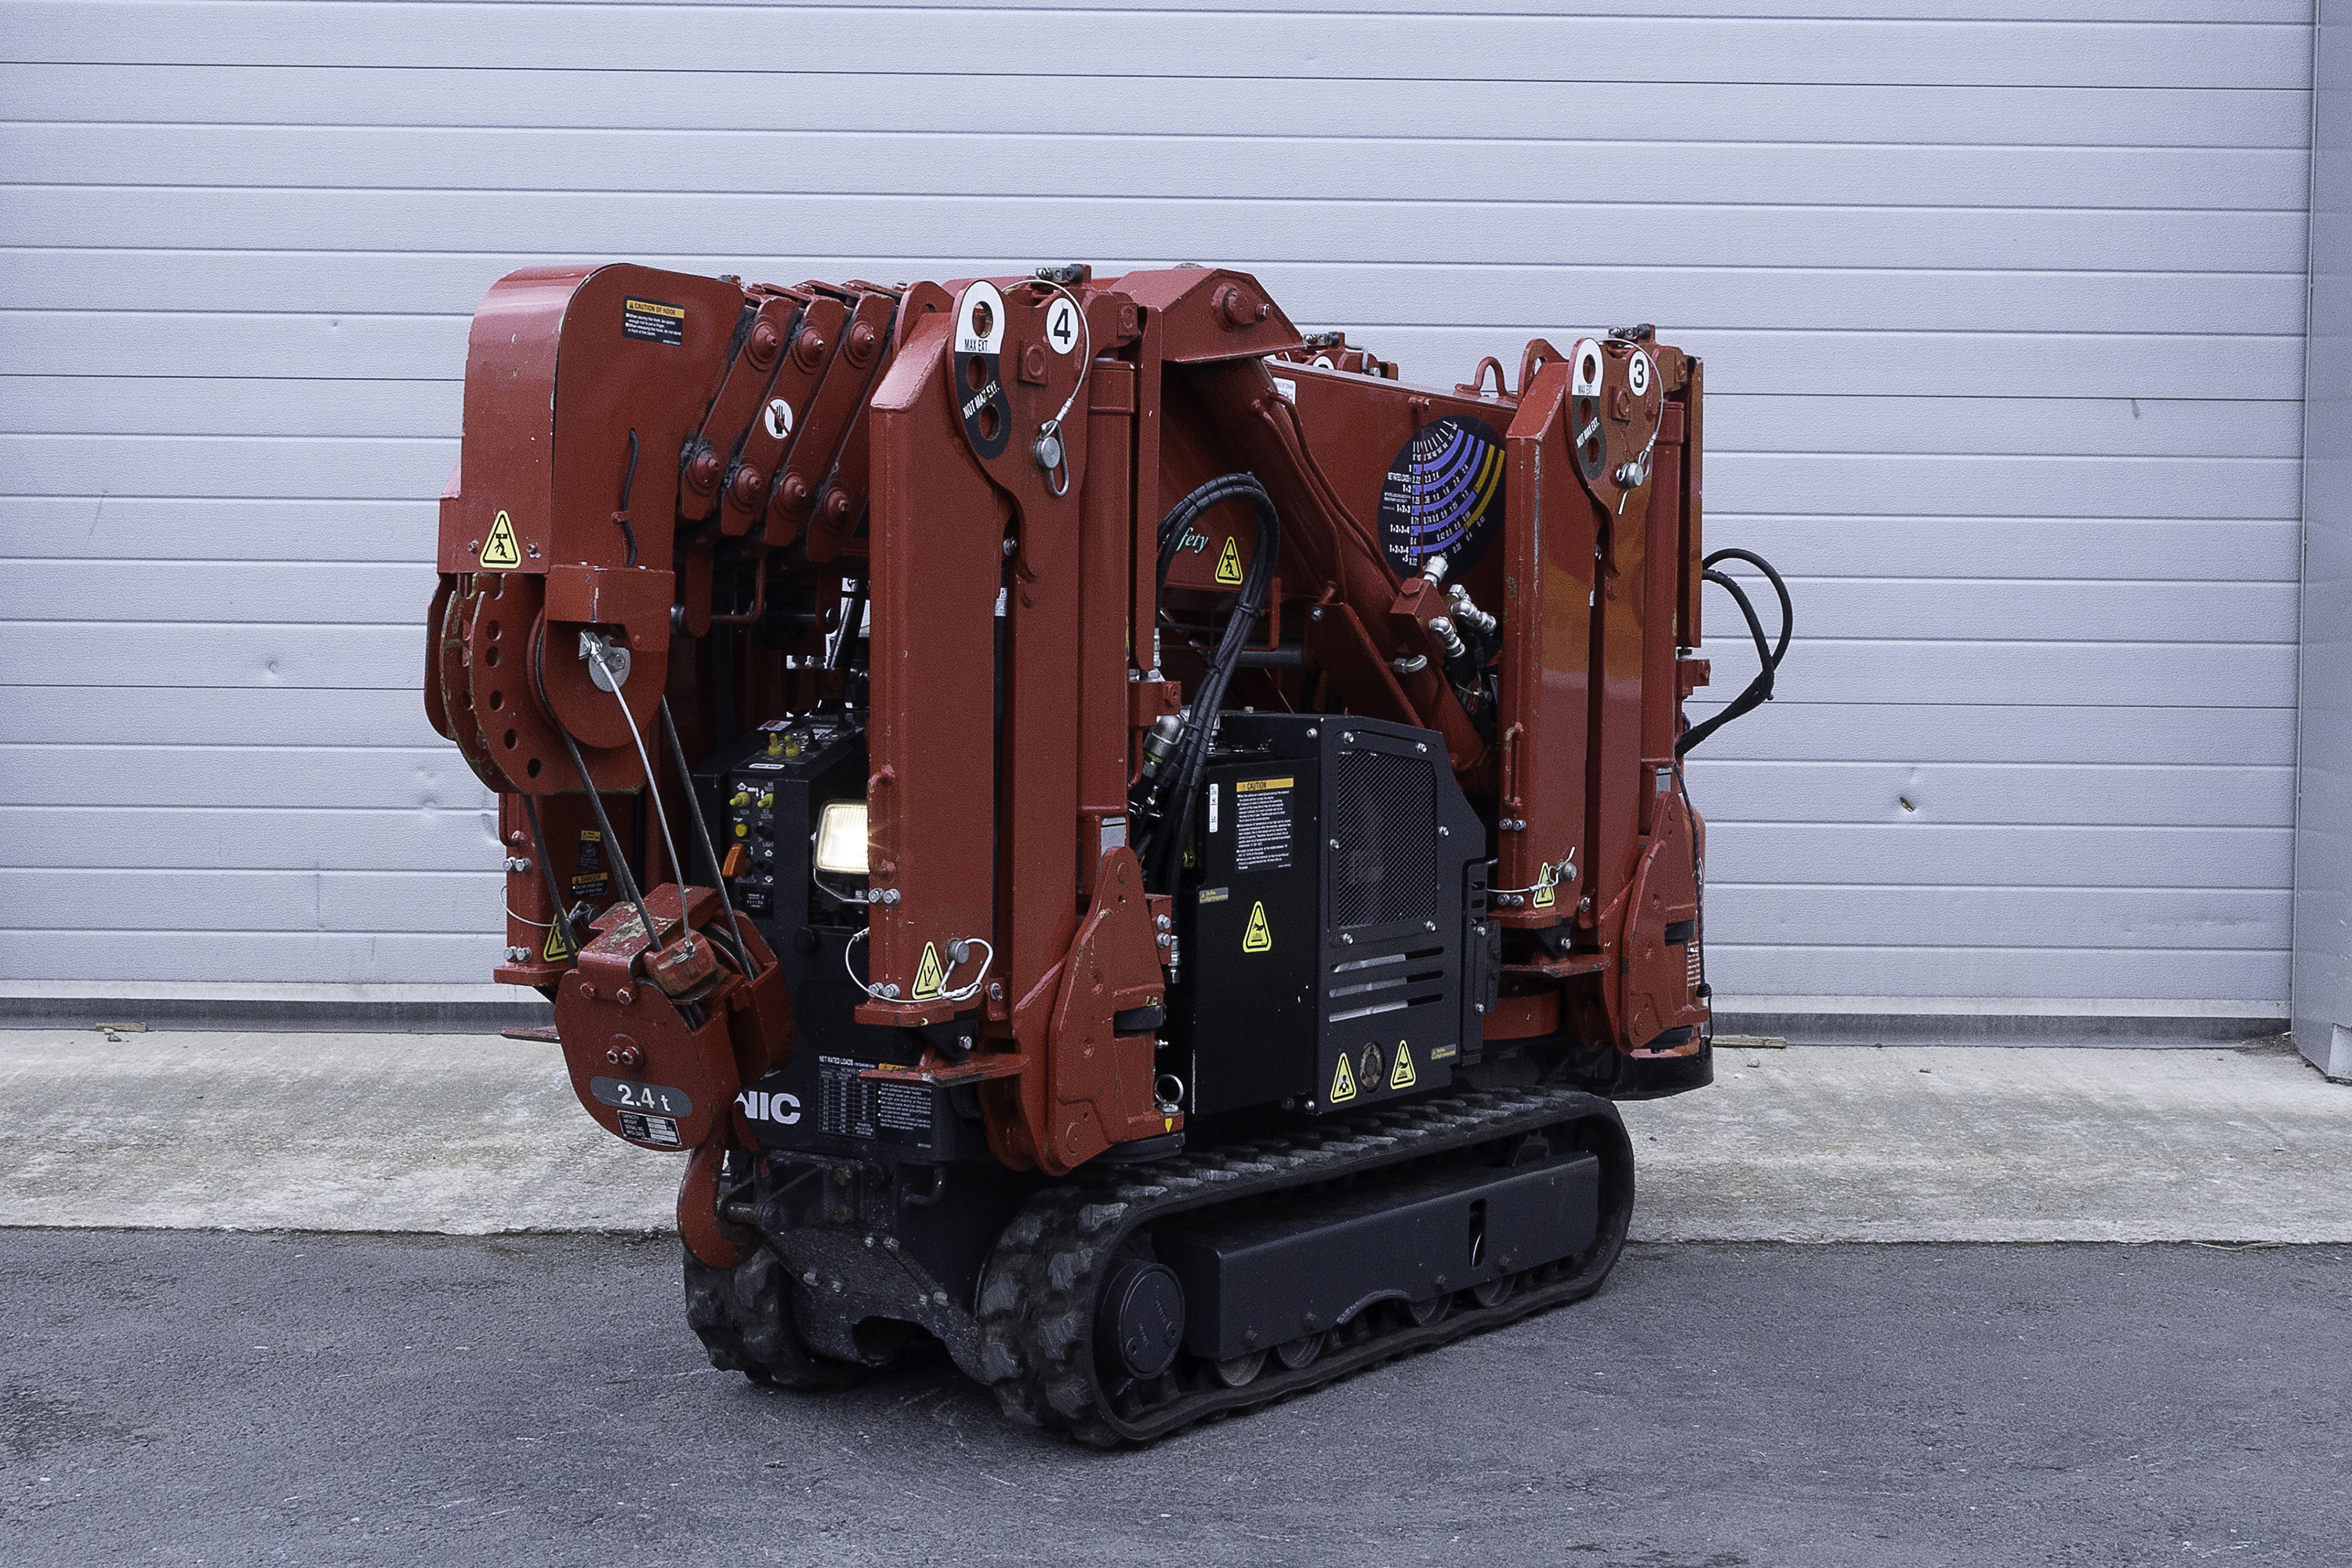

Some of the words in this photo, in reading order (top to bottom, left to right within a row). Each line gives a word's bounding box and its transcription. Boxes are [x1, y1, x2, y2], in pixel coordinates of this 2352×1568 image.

[635, 303, 655, 312] CAUTION
[1054, 308, 1071, 345] 4
[964, 339, 978, 351] MAX
[978, 340, 990, 353] EXT.
[1634, 359, 1645, 388] 3
[963, 399, 976, 419] NOT
[975, 390, 989, 408] MAX
[986, 380, 1000, 398] EXT.
[1590, 417, 1600, 432] EXT.
[1403, 485, 1412, 493] 1+2
[1396, 504, 1411, 514] 1+2+3
[1390, 524, 1410, 534] 1+2+3+4
[1163, 527, 1209, 554] fety
[1389, 545, 1410, 554] 1+2+3+4
[1247, 781, 1267, 790] CAUTION
[828, 1056, 840, 1065] RATED
[840, 1058, 854, 1066] LOADS
[618, 1083, 655, 1109] 2.4
[661, 1094, 671, 1112] t
[734, 1091, 800, 1125] NIC
